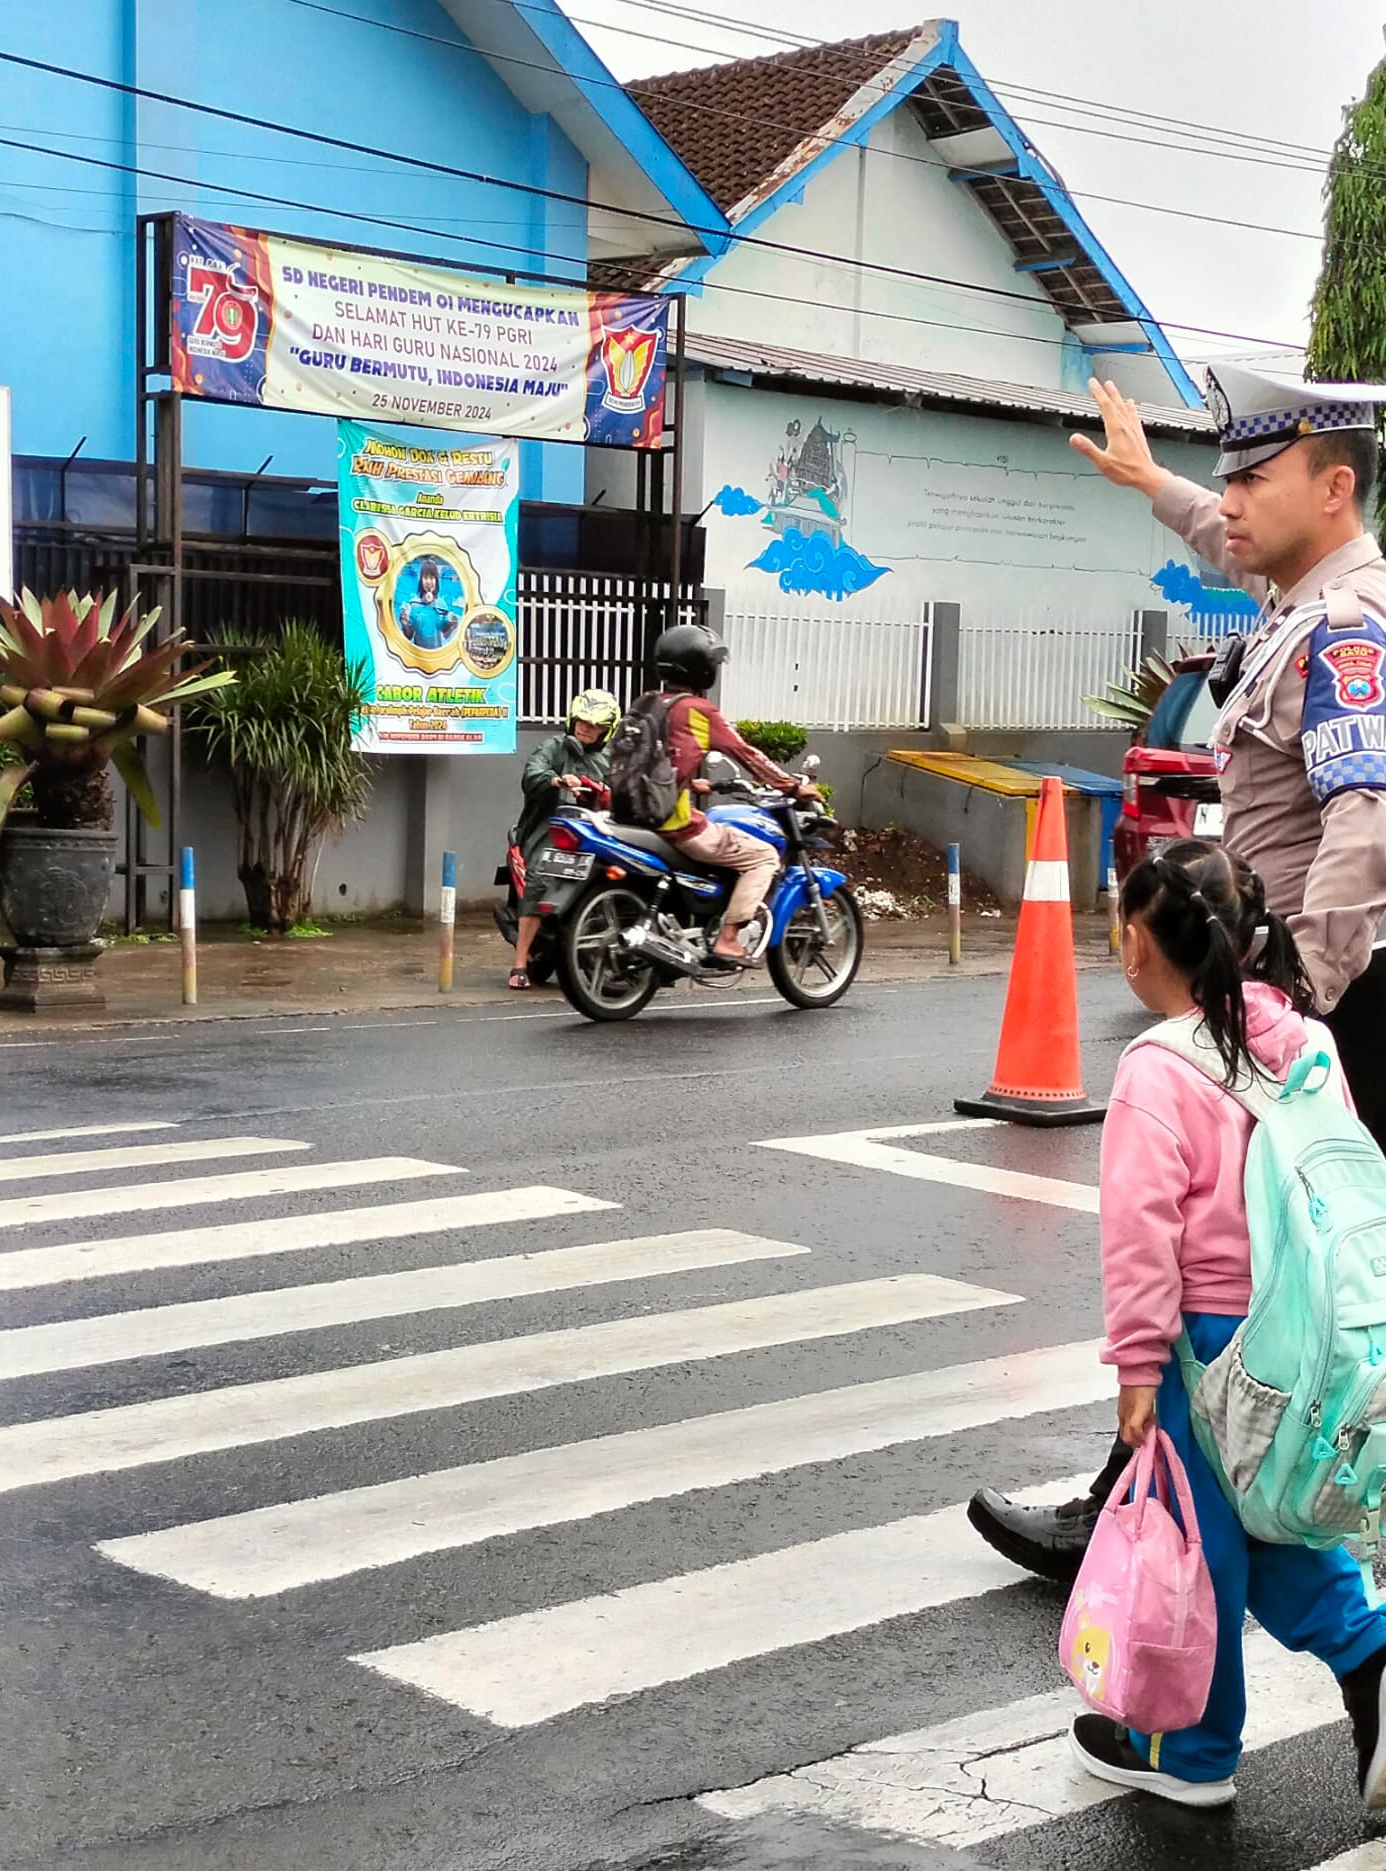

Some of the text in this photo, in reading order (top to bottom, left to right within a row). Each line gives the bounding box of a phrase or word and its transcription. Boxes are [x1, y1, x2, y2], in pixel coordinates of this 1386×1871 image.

[190, 263, 258, 360] 79
[282, 266, 303, 284] SD
[308, 270, 363, 296] NEGERI
[368, 281, 431, 307] PENDEM
[458, 296, 580, 326] MENGUCAPKAN
[335, 301, 532, 345] SELAMAT HUT KE-79 PGRI
[312, 323, 558, 373] DAN HARI GURU NASIONAL 2024
[290, 347, 568, 397] "GURU BERMUTU, INDONESIA MAJU"
[372, 393, 492, 420] 25 NOVEMBER 2024
[353, 456, 384, 475] RAIH
[385, 463, 442, 483] PRESTASI
[365, 439, 493, 466] MOHON DOA & RESTU
[376, 685, 486, 704] CABOR ATLETIK
